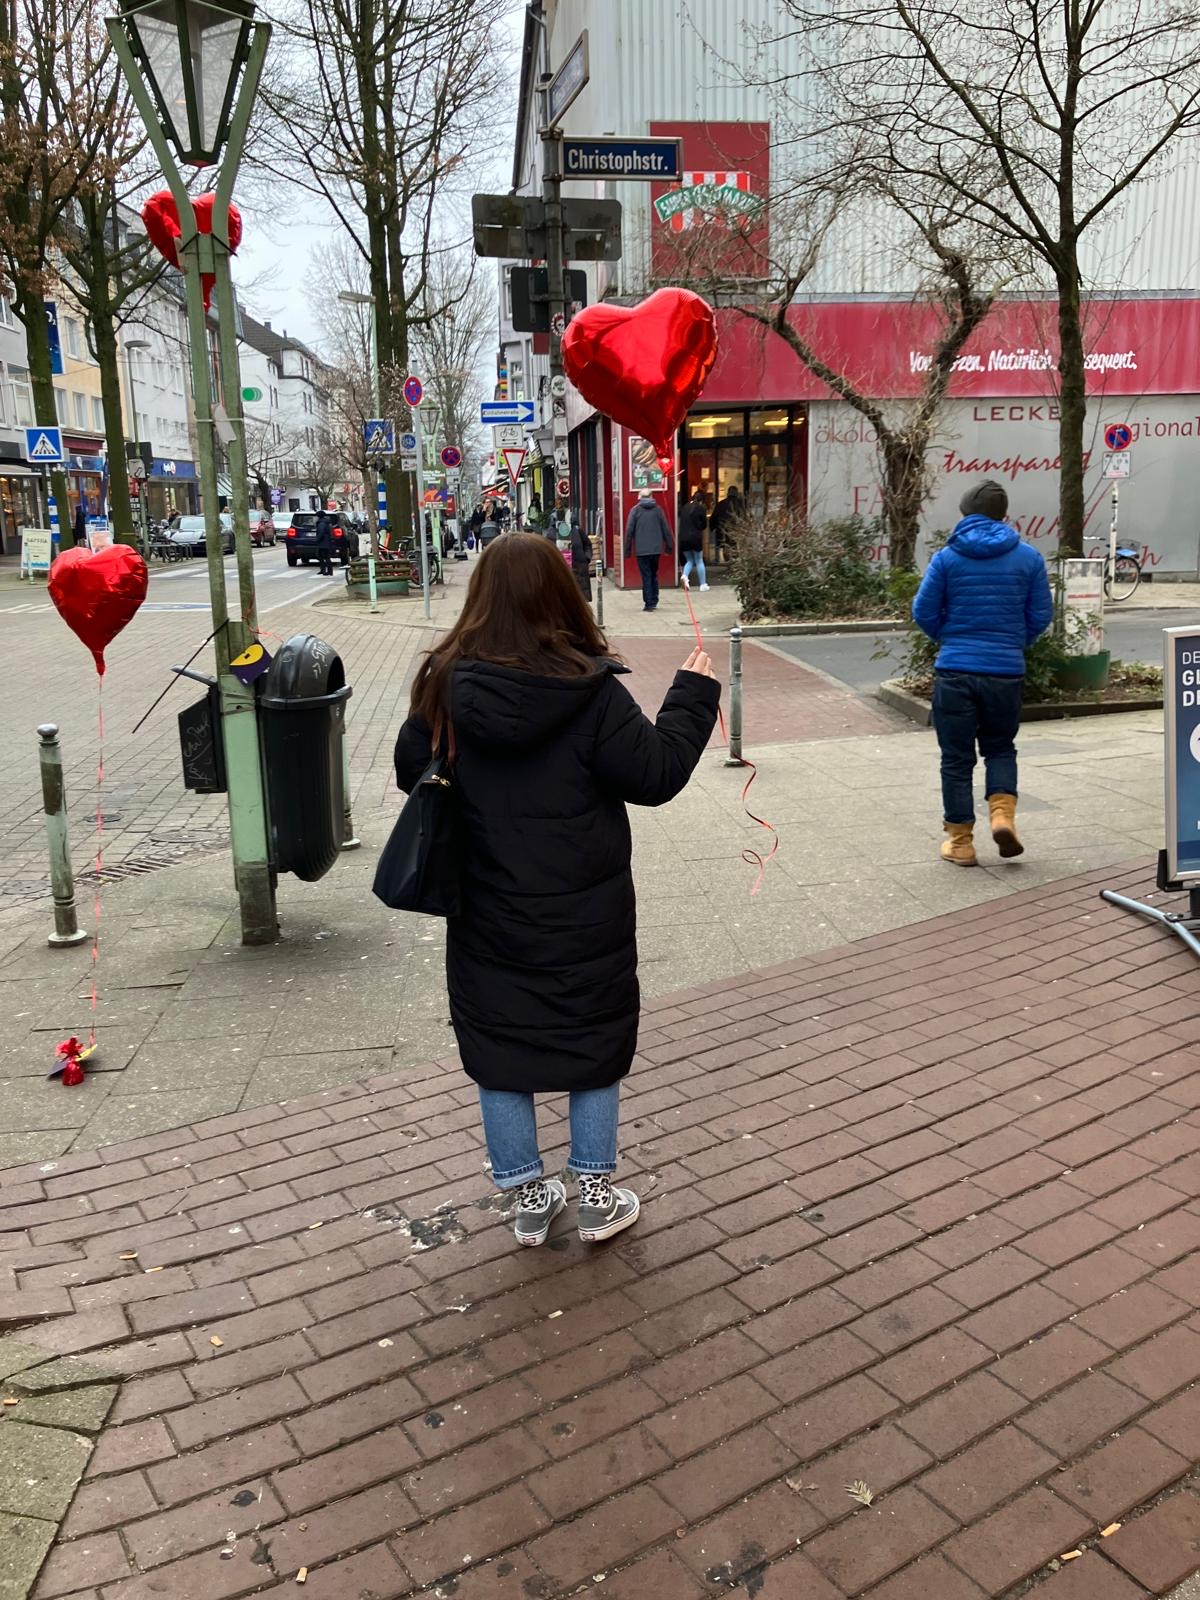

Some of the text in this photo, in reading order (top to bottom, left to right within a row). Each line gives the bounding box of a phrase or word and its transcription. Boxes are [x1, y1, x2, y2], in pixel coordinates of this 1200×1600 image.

[567, 149, 669, 175] Christophstr.
[1083, 350, 1138, 374] sequent.
[973, 406, 1062, 421] LECKE
[1104, 416, 1200, 442] rgional
[944, 450, 1091, 481] transparet
